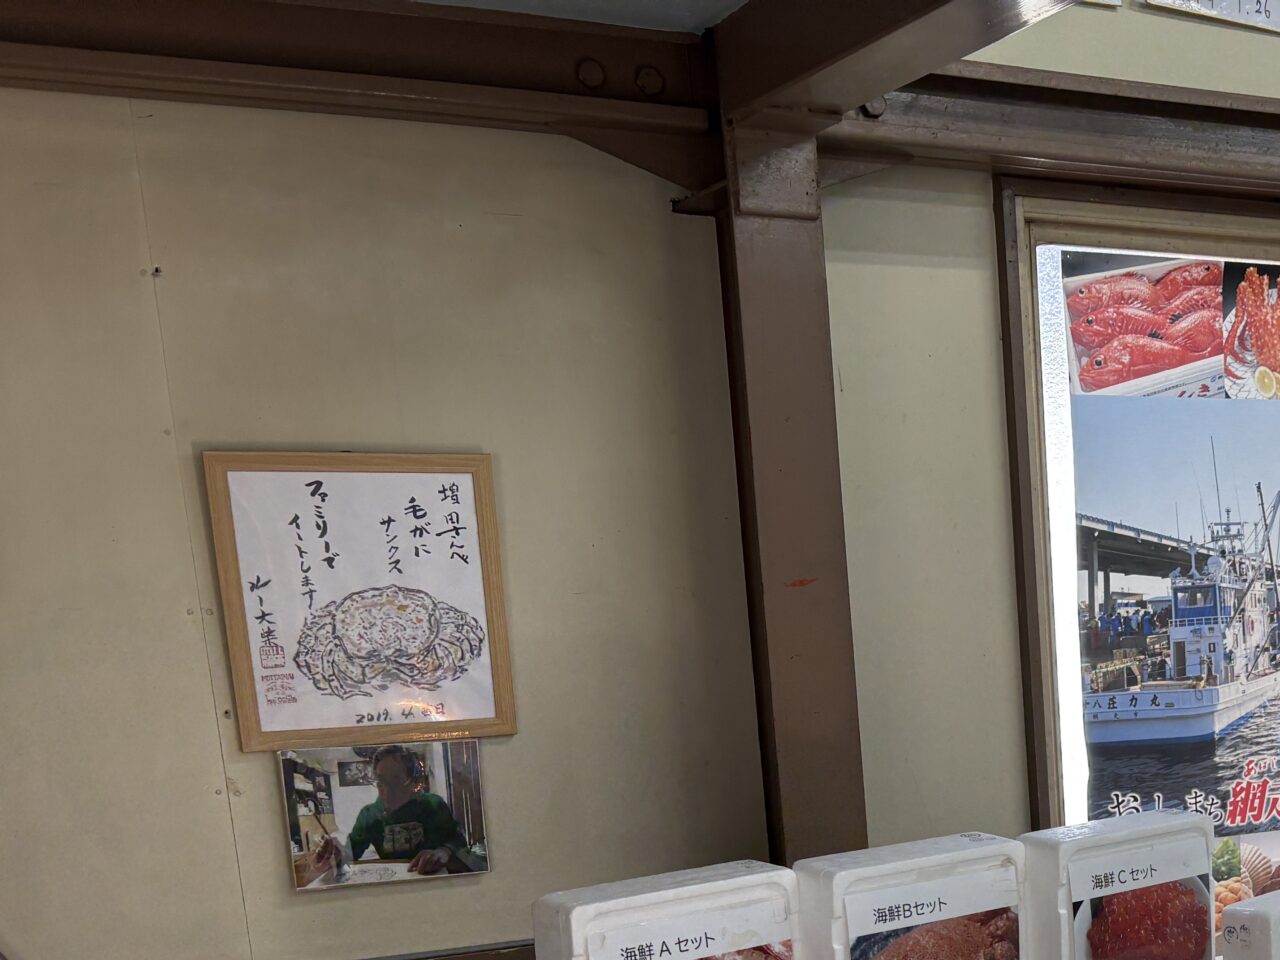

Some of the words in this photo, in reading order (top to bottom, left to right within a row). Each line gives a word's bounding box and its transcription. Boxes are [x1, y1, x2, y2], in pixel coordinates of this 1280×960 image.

[379, 515, 404, 575] サンクス
[403, 496, 432, 558] 毛がに
[872, 897, 948, 925] 海鮮Bセット
